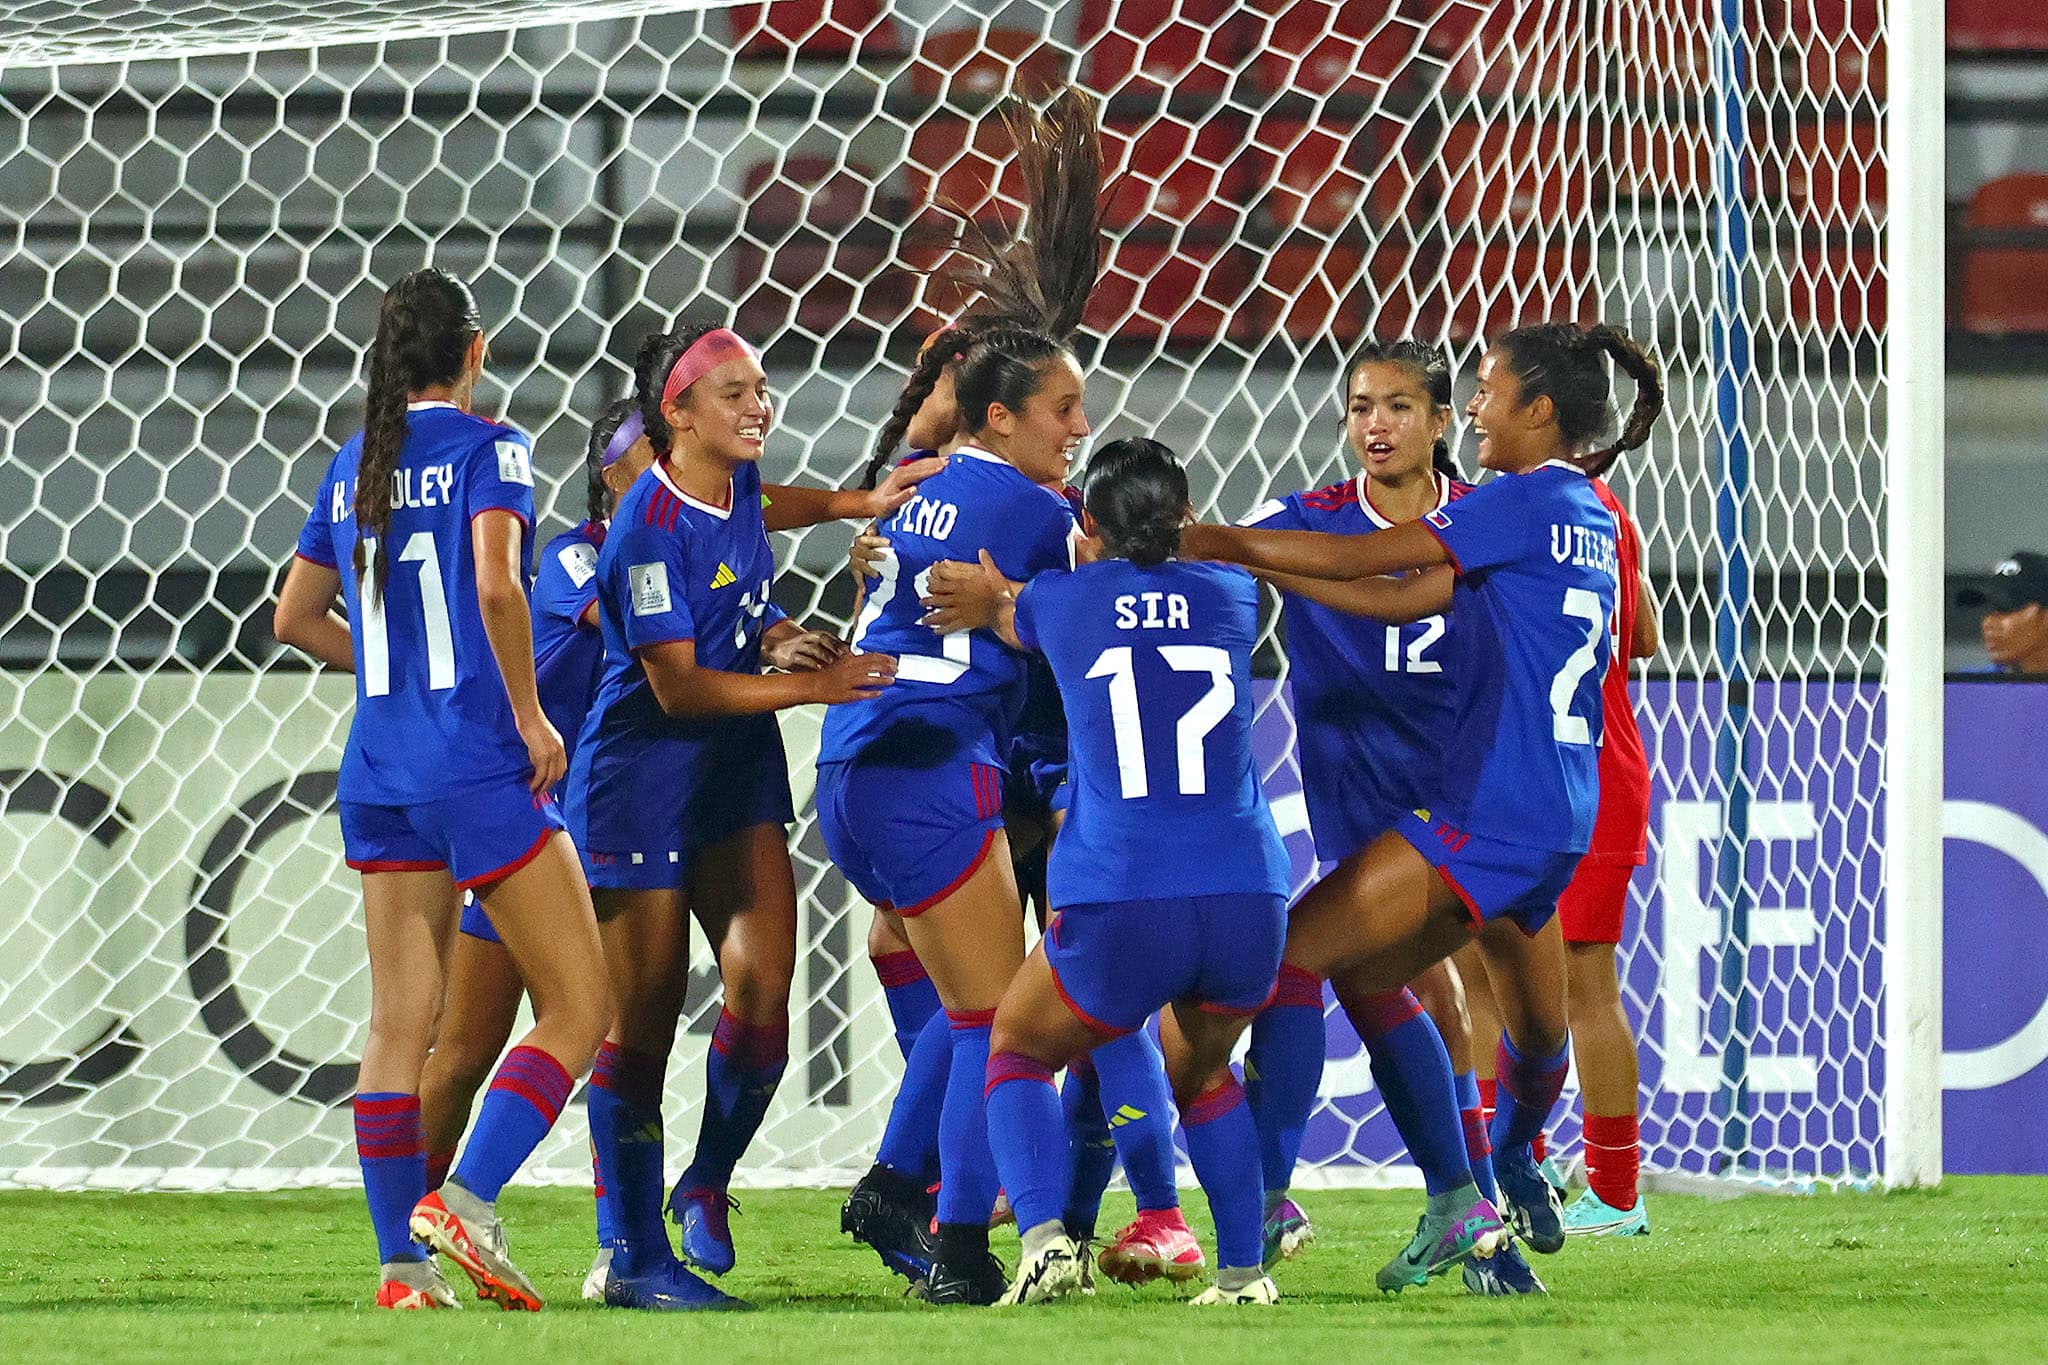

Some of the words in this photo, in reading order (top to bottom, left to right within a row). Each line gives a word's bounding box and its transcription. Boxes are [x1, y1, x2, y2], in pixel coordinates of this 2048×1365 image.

[354, 463, 454, 510] DLEY
[360, 531, 455, 698] 11
[1114, 591, 1190, 630] SIR
[1385, 614, 1446, 673] 12
[1084, 645, 1236, 800] 17
